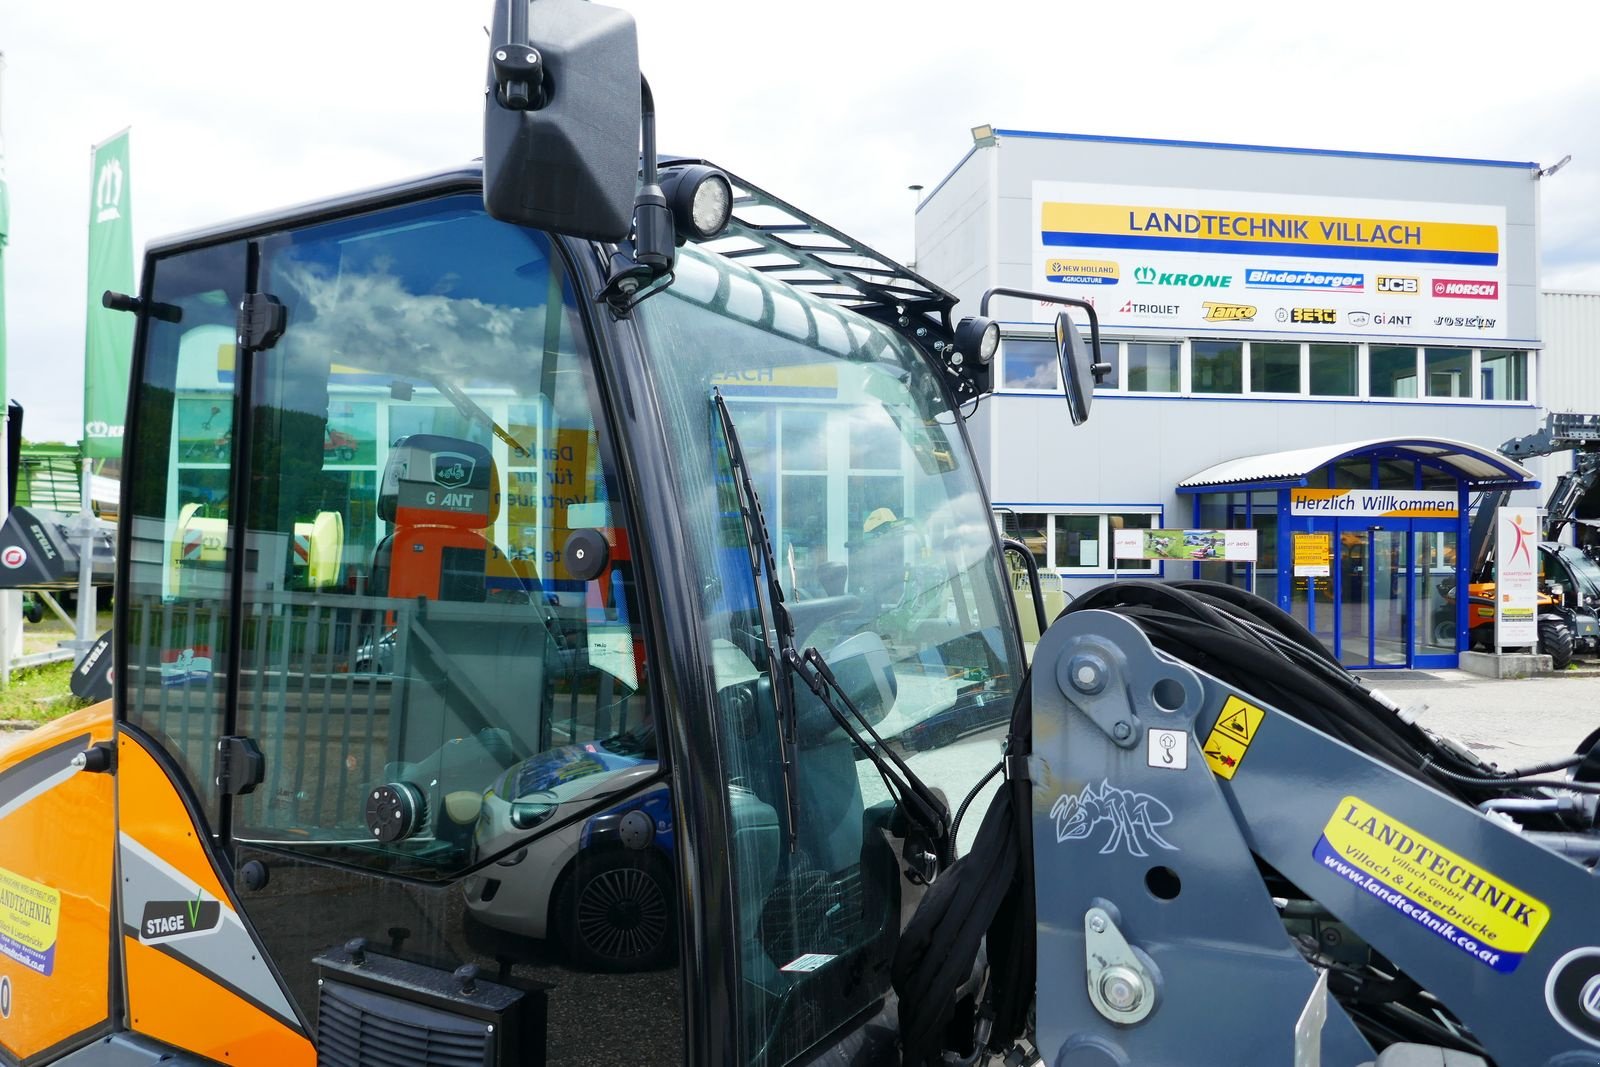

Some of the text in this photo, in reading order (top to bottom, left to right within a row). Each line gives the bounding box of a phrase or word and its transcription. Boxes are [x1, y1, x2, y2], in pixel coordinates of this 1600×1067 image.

[1129, 211, 1422, 246] LANDTECHNIK VILLACH
[1062, 264, 1114, 274] NEW HOLLAND
[1248, 269, 1362, 288] Binderberger
[1062, 276, 1102, 284] AGRICULTURE
[1158, 273, 1232, 288] KRONE
[1378, 278, 1417, 293] JCB
[1445, 283, 1496, 296] HORSCH
[1132, 303, 1180, 314] TRIOLIET
[1202, 302, 1257, 322] Tanco
[425, 490, 474, 508] GANT
[1295, 495, 1455, 512] Herzlich Willkommen
[1342, 804, 1537, 928] LANDTECHNIK
[1391, 855, 1465, 902] Villach GmbH
[1345, 844, 1498, 941] Villach & Lieserbrücke
[0, 888, 52, 926] ANDTECHNIK
[1323, 853, 1500, 966] www.landtechnik.co.at
[147, 915, 185, 935] STAGE
